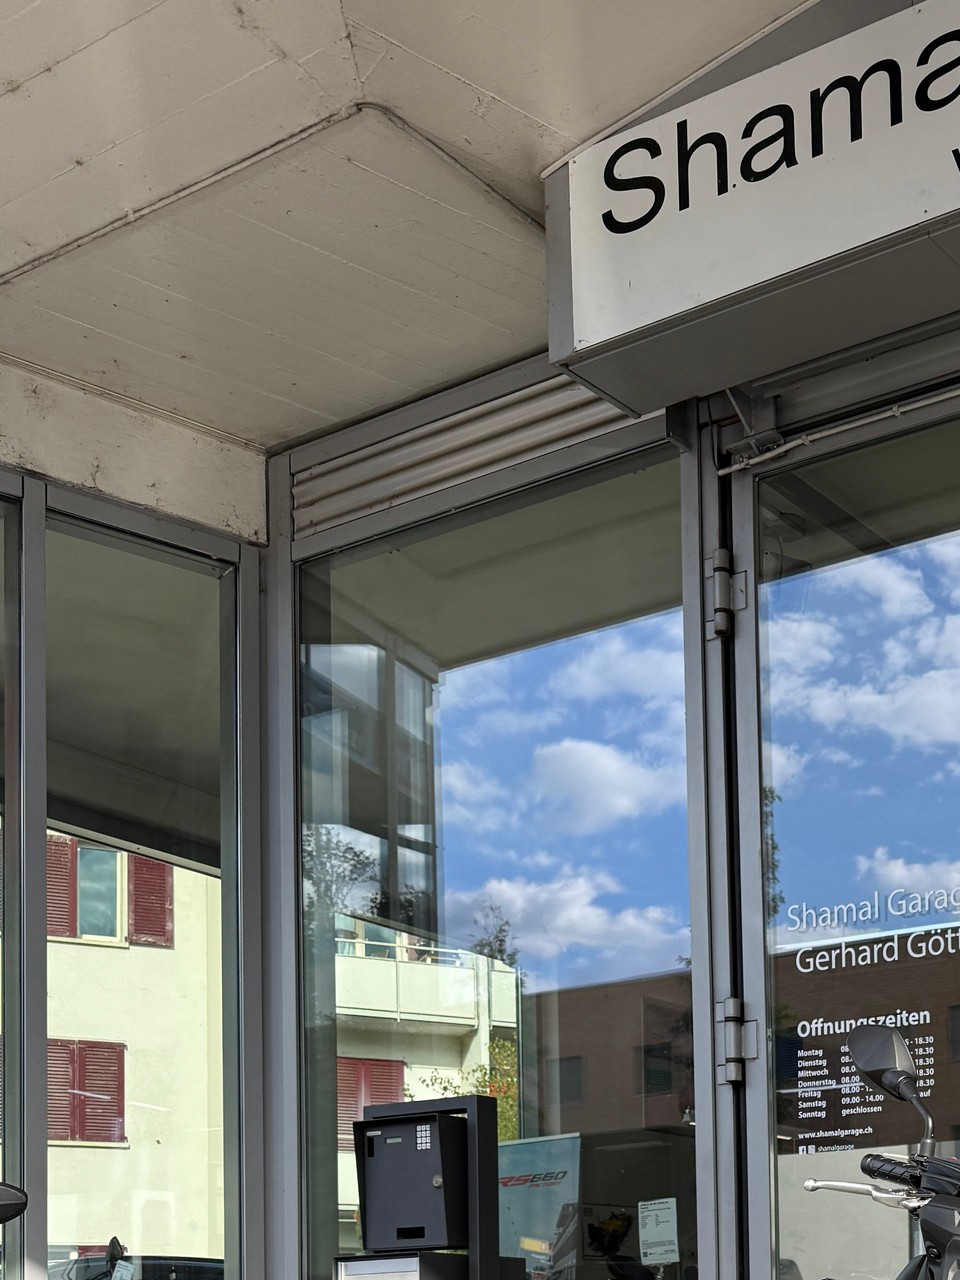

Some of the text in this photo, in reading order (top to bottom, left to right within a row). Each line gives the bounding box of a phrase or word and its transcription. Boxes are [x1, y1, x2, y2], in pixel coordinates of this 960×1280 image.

[787, 891, 880, 932] Shamal
[795, 934, 899, 974] Gerhard
[797, 1049, 823, 1057] Montag
[914, 1035, 934, 1045] 18.30
[797, 1058, 827, 1068] Dienstag
[914, 1046, 935, 1056] 18.30
[797, 1057, 935, 1078] Mittwoch 08.0 18.30
[797, 1079, 837, 1088] Donnerstag
[840, 1075, 861, 1084] 08.00
[798, 1090, 822, 1099] Freitag
[841, 1086, 861, 1095] 08.00
[798, 1100, 827, 1109] Samstag
[841, 1096, 861, 1105] 09.00
[865, 1094, 885, 1102] 14.00
[798, 1105, 883, 1119] Sonntag geschlossen
[797, 1126, 873, 1140] www.shamalgarage.ch
